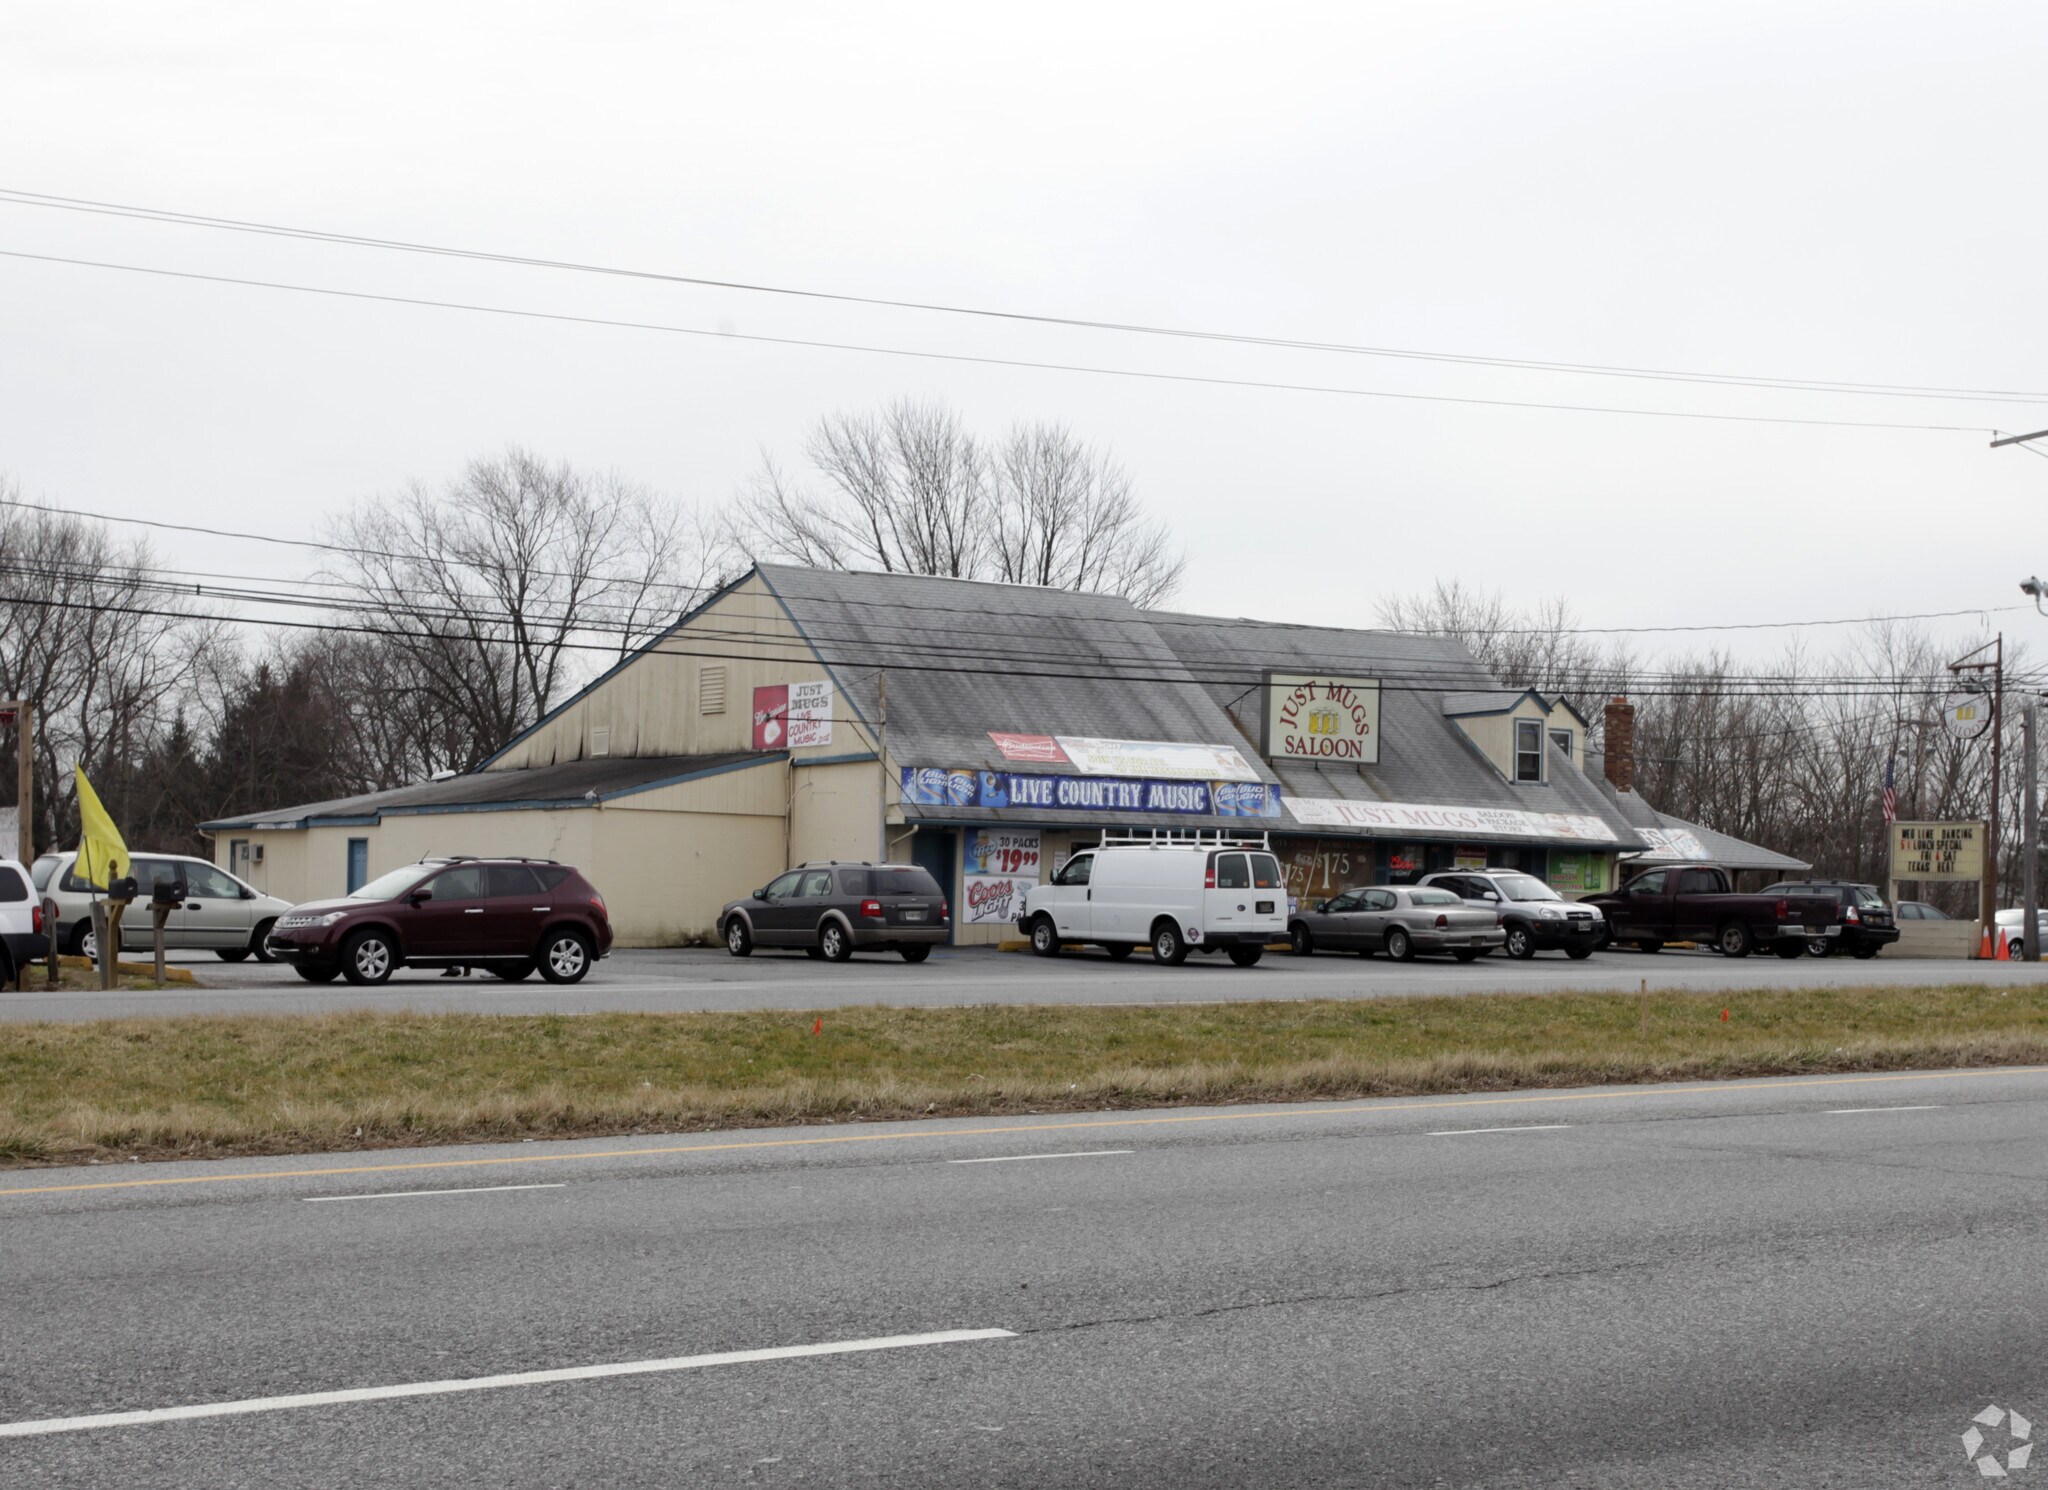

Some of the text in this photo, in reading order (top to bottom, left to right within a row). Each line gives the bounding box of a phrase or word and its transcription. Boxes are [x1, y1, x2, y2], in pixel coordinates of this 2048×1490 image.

[796, 684, 822, 697] JUST
[791, 695, 829, 710] MUGS
[1279, 680, 1370, 736] JUST MUGS
[796, 710, 812, 722] LIVE
[788, 716, 823, 737] COUNTRY
[793, 732, 816, 745] MUSIC
[1284, 735, 1363, 758] SALOON
[925, 770, 948, 781] BUD
[948, 781, 974, 798] LIGHT
[954, 777, 975, 792] BUD
[1010, 778, 1205, 810] LIVE COUNTRY MUSIC
[1220, 787, 1237, 795] BU
[1236, 793, 1266, 801] LIGHT
[1335, 805, 1397, 824] JUST
[1400, 809, 1478, 829] MUGS
[1476, 810, 1516, 819] SALOON
[1484, 818, 1529, 827] PACKAGE
[1493, 825, 1526, 833] STORE
[1917, 829, 1934, 839] LINE
[1942, 828, 1973, 839] DANCING
[999, 836, 1039, 848] 30 PACKS
[1913, 840, 1935, 851] LUNCH
[1936, 840, 1963, 850] SPECIAL
[1920, 851, 1932, 861] FRI
[1943, 851, 1957, 861] SAT
[1908, 861, 1931, 872] TEXAS
[967, 878, 1015, 908] Coors
[971, 895, 1013, 922] LIGHT
